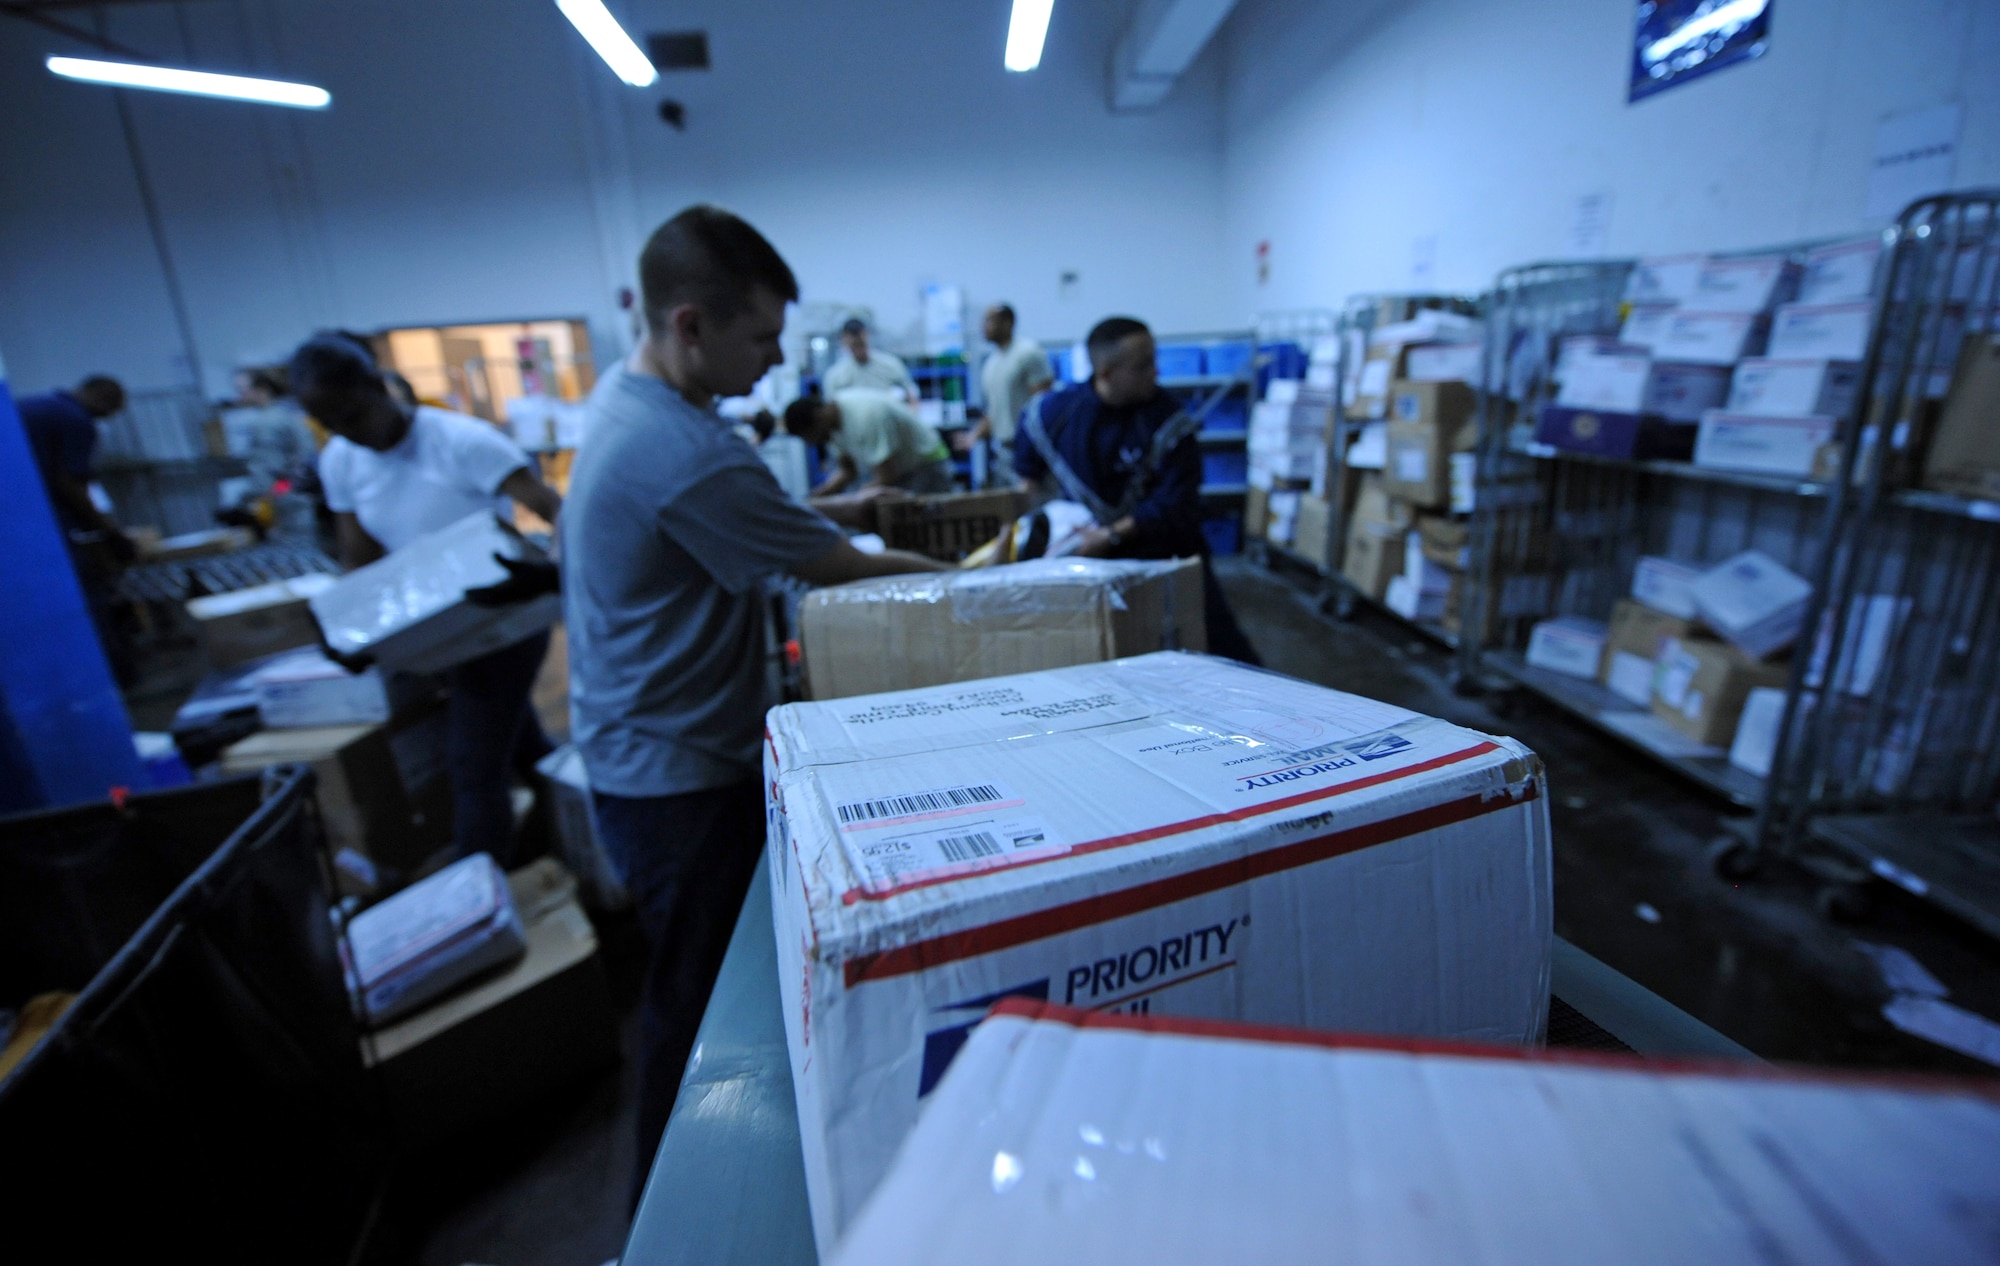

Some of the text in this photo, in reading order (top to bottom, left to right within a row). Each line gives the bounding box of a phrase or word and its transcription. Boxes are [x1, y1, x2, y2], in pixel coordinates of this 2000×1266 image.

[1271, 747, 1338, 766] MAIL
[1246, 758, 1357, 791] PRIORITY
[1065, 918, 1238, 1006] PRIORITY
